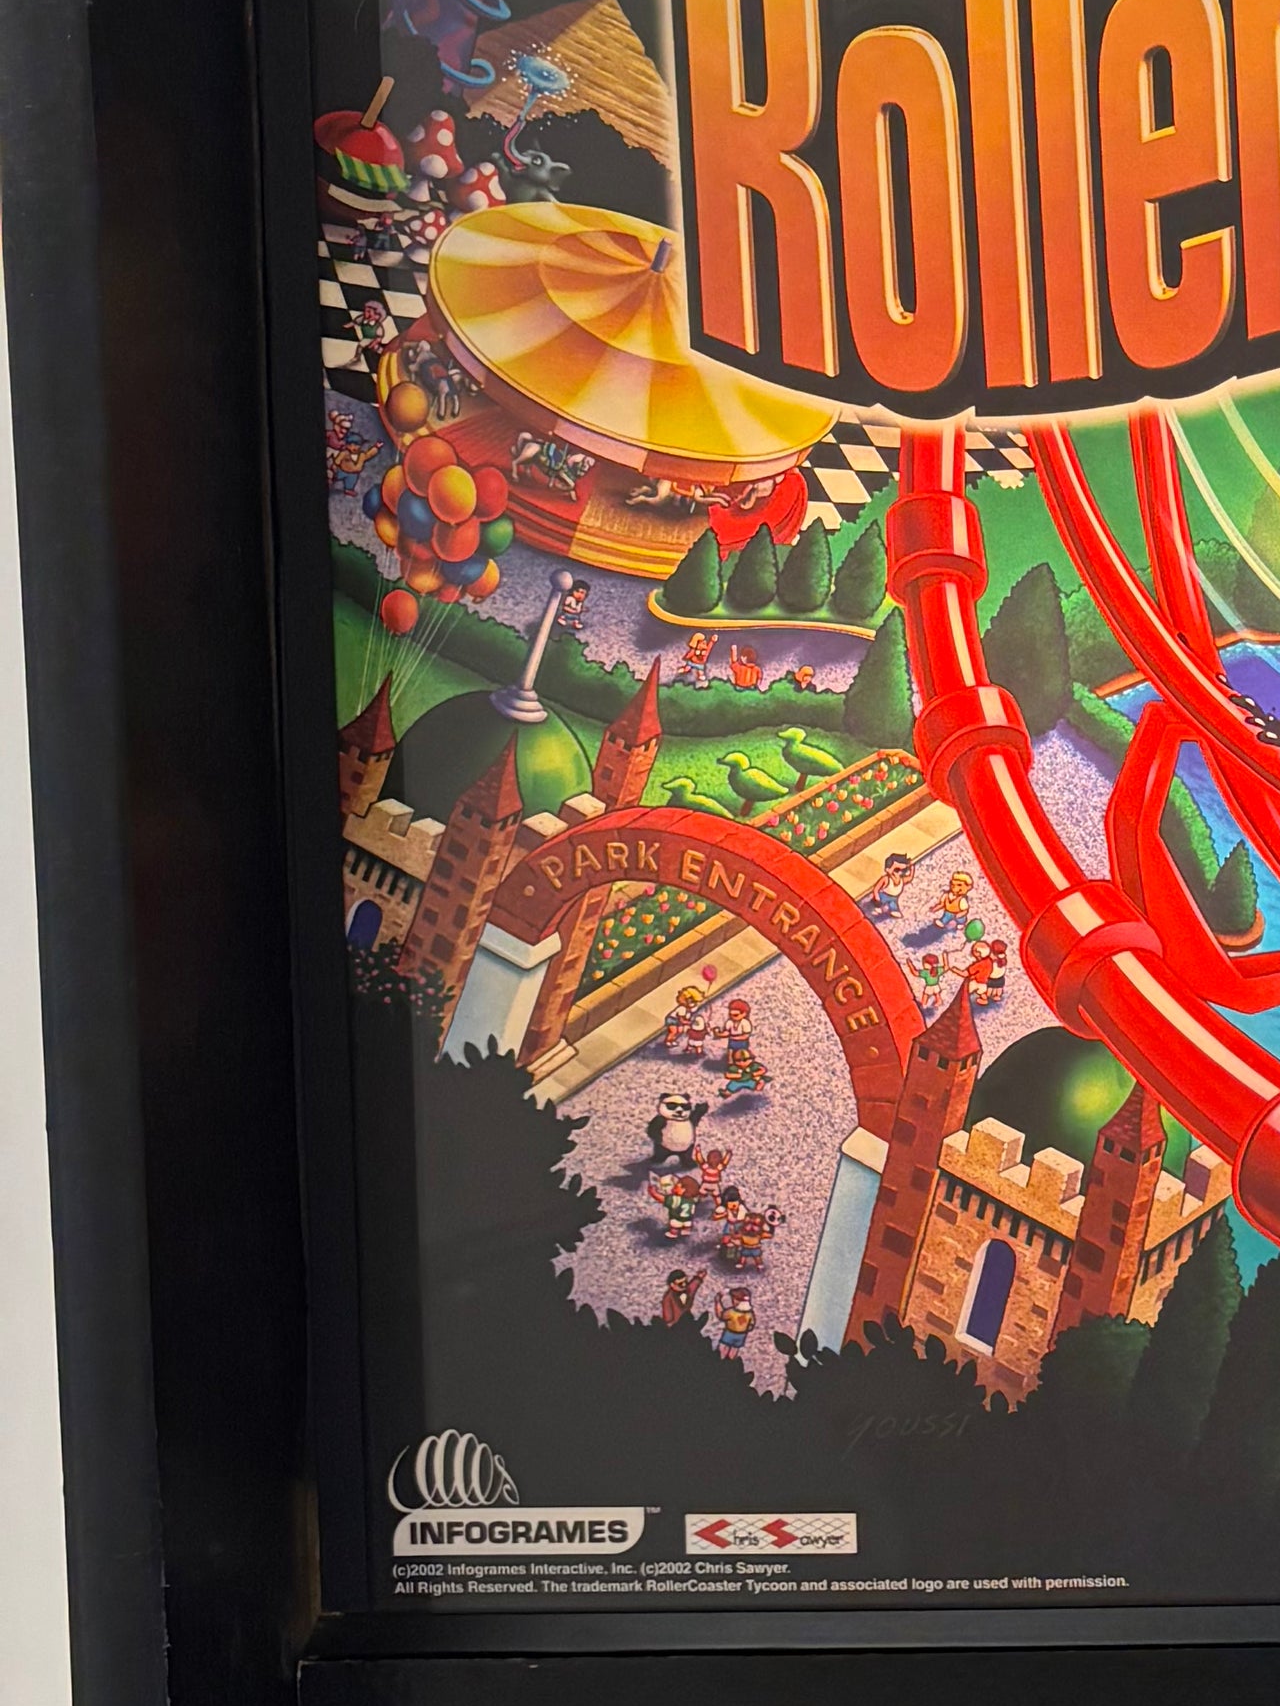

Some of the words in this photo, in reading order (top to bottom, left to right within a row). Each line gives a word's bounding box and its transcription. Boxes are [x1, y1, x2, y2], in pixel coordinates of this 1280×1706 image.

[538, 839, 662, 890] PARK
[678, 848, 881, 1033] ENTRANCE
[409, 1519, 629, 1545] INFOGRAMES
[392, 1563, 444, 1578] (c)2002
[447, 1563, 527, 1578] Infogrames
[611, 1562, 637, 1575] Inc.
[640, 1562, 692, 1577] (c)2002
[694, 1561, 733, 1575] Chris
[736, 1561, 791, 1577] Sawyer.
[394, 1581, 415, 1594] All
[417, 1580, 464, 1596] Rights
[467, 1580, 538, 1594] Reserved.
[541, 1580, 568, 1593] The
[571, 1579, 643, 1592] trademark
[646, 1579, 742, 1592] RollerCoaster
[745, 1579, 797, 1595] Tycoon
[800, 1578, 828, 1591] and
[830, 1578, 908, 1591] associated
[911, 1578, 943, 1593] logo
[946, 1579, 970, 1590] are
[973, 1577, 1009, 1590] used
[1011, 1576, 1042, 1589] with
[1045, 1575, 1130, 1591] permission.
